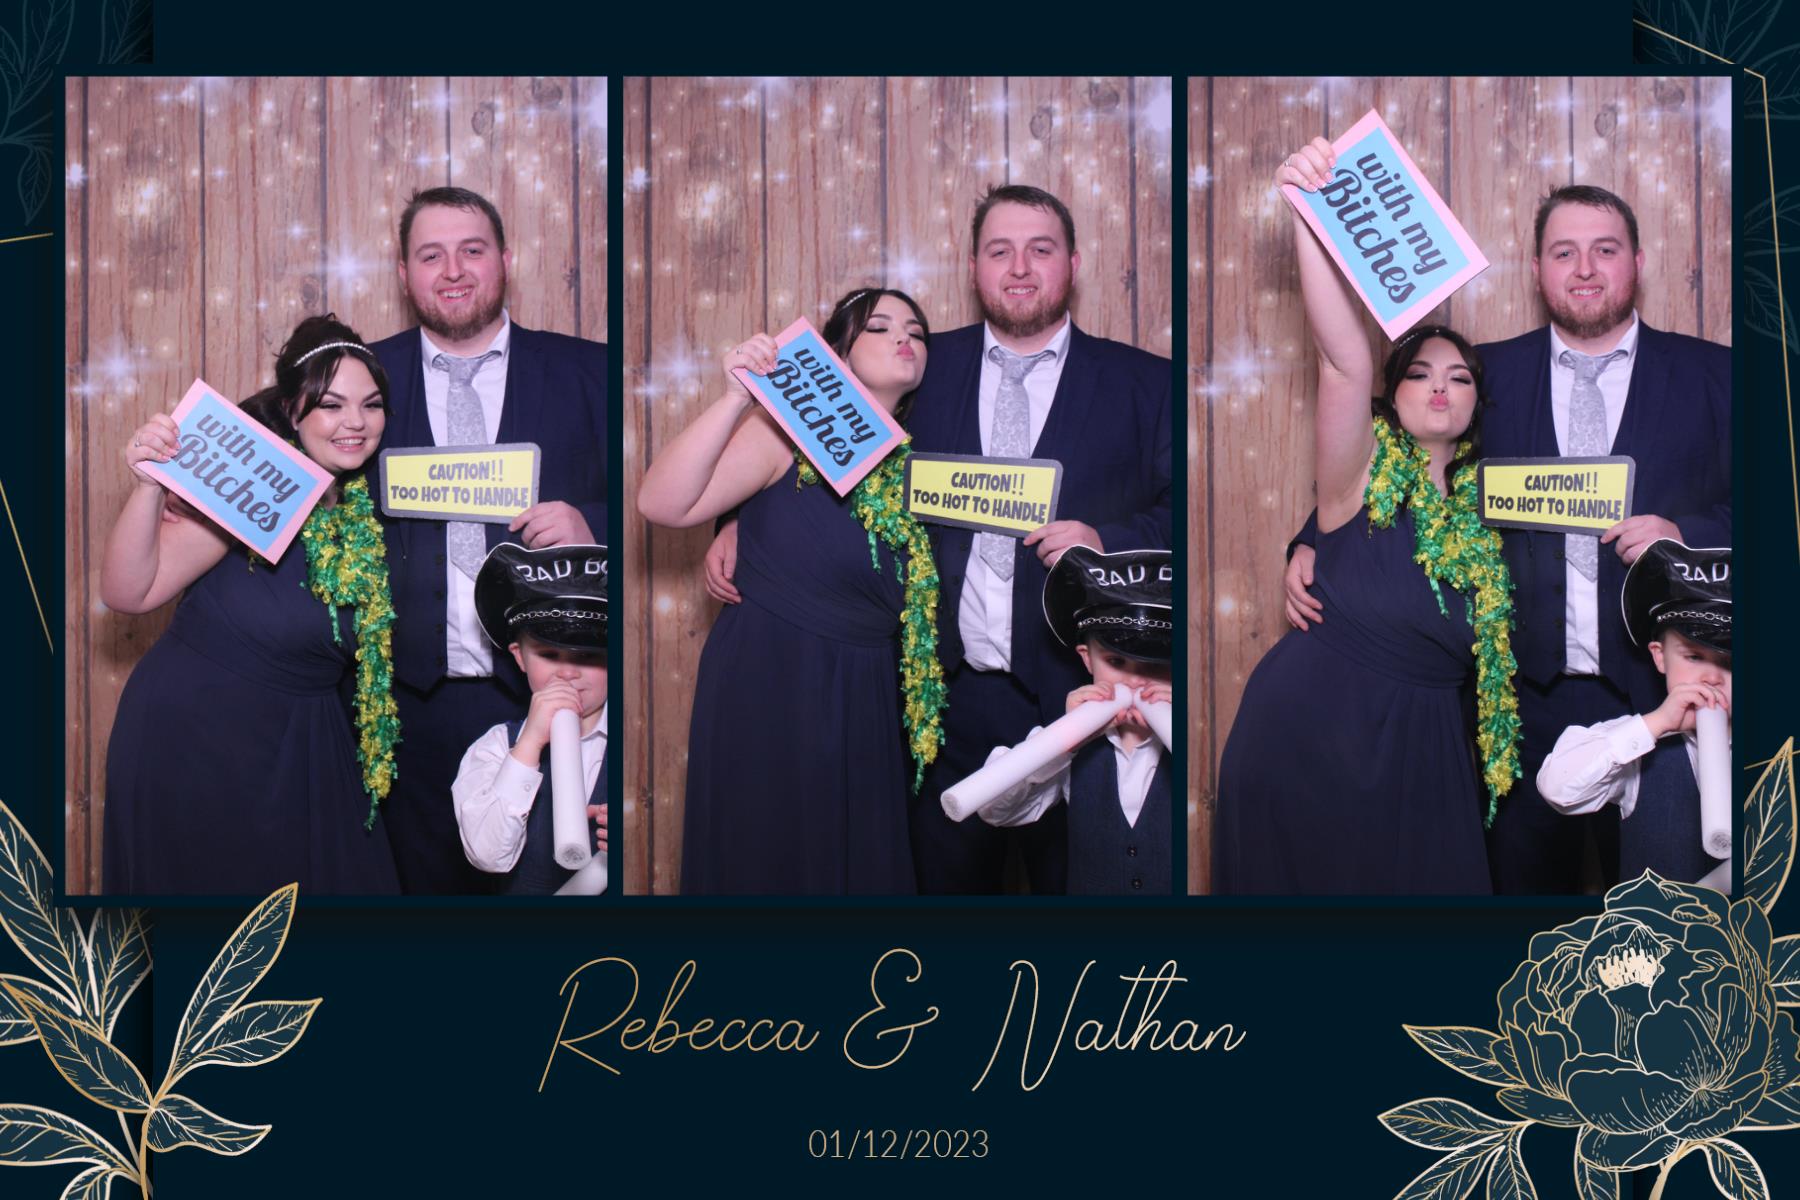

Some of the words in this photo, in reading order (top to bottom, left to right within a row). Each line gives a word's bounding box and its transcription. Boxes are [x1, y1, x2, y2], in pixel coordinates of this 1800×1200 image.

[1319, 168, 1417, 304] Bitches
[1356, 152, 1414, 222] with
[1400, 222, 1448, 276] my
[767, 359, 855, 467] Bitches
[794, 348, 844, 401] with
[836, 402, 876, 444] my
[171, 434, 281, 532] Bitches
[196, 414, 256, 466] with
[252, 460, 300, 503] my
[428, 459, 503, 482] CAUTION!!
[951, 472, 1025, 496] CAUTION!!
[1524, 472, 1598, 494] CAUTION!!
[391, 485, 418, 500] TOO
[421, 486, 449, 503] HOT
[452, 486, 470, 503] TO
[474, 487, 529, 508] HANDLE
[913, 489, 939, 506] TOO
[942, 493, 970, 511] HOT
[972, 496, 990, 514] TO
[992, 498, 1047, 524] HANDLE
[1487, 495, 1514, 511] TOO
[1517, 496, 1544, 514] HOT
[1547, 498, 1564, 515] TO
[1567, 498, 1621, 521] HANDLE
